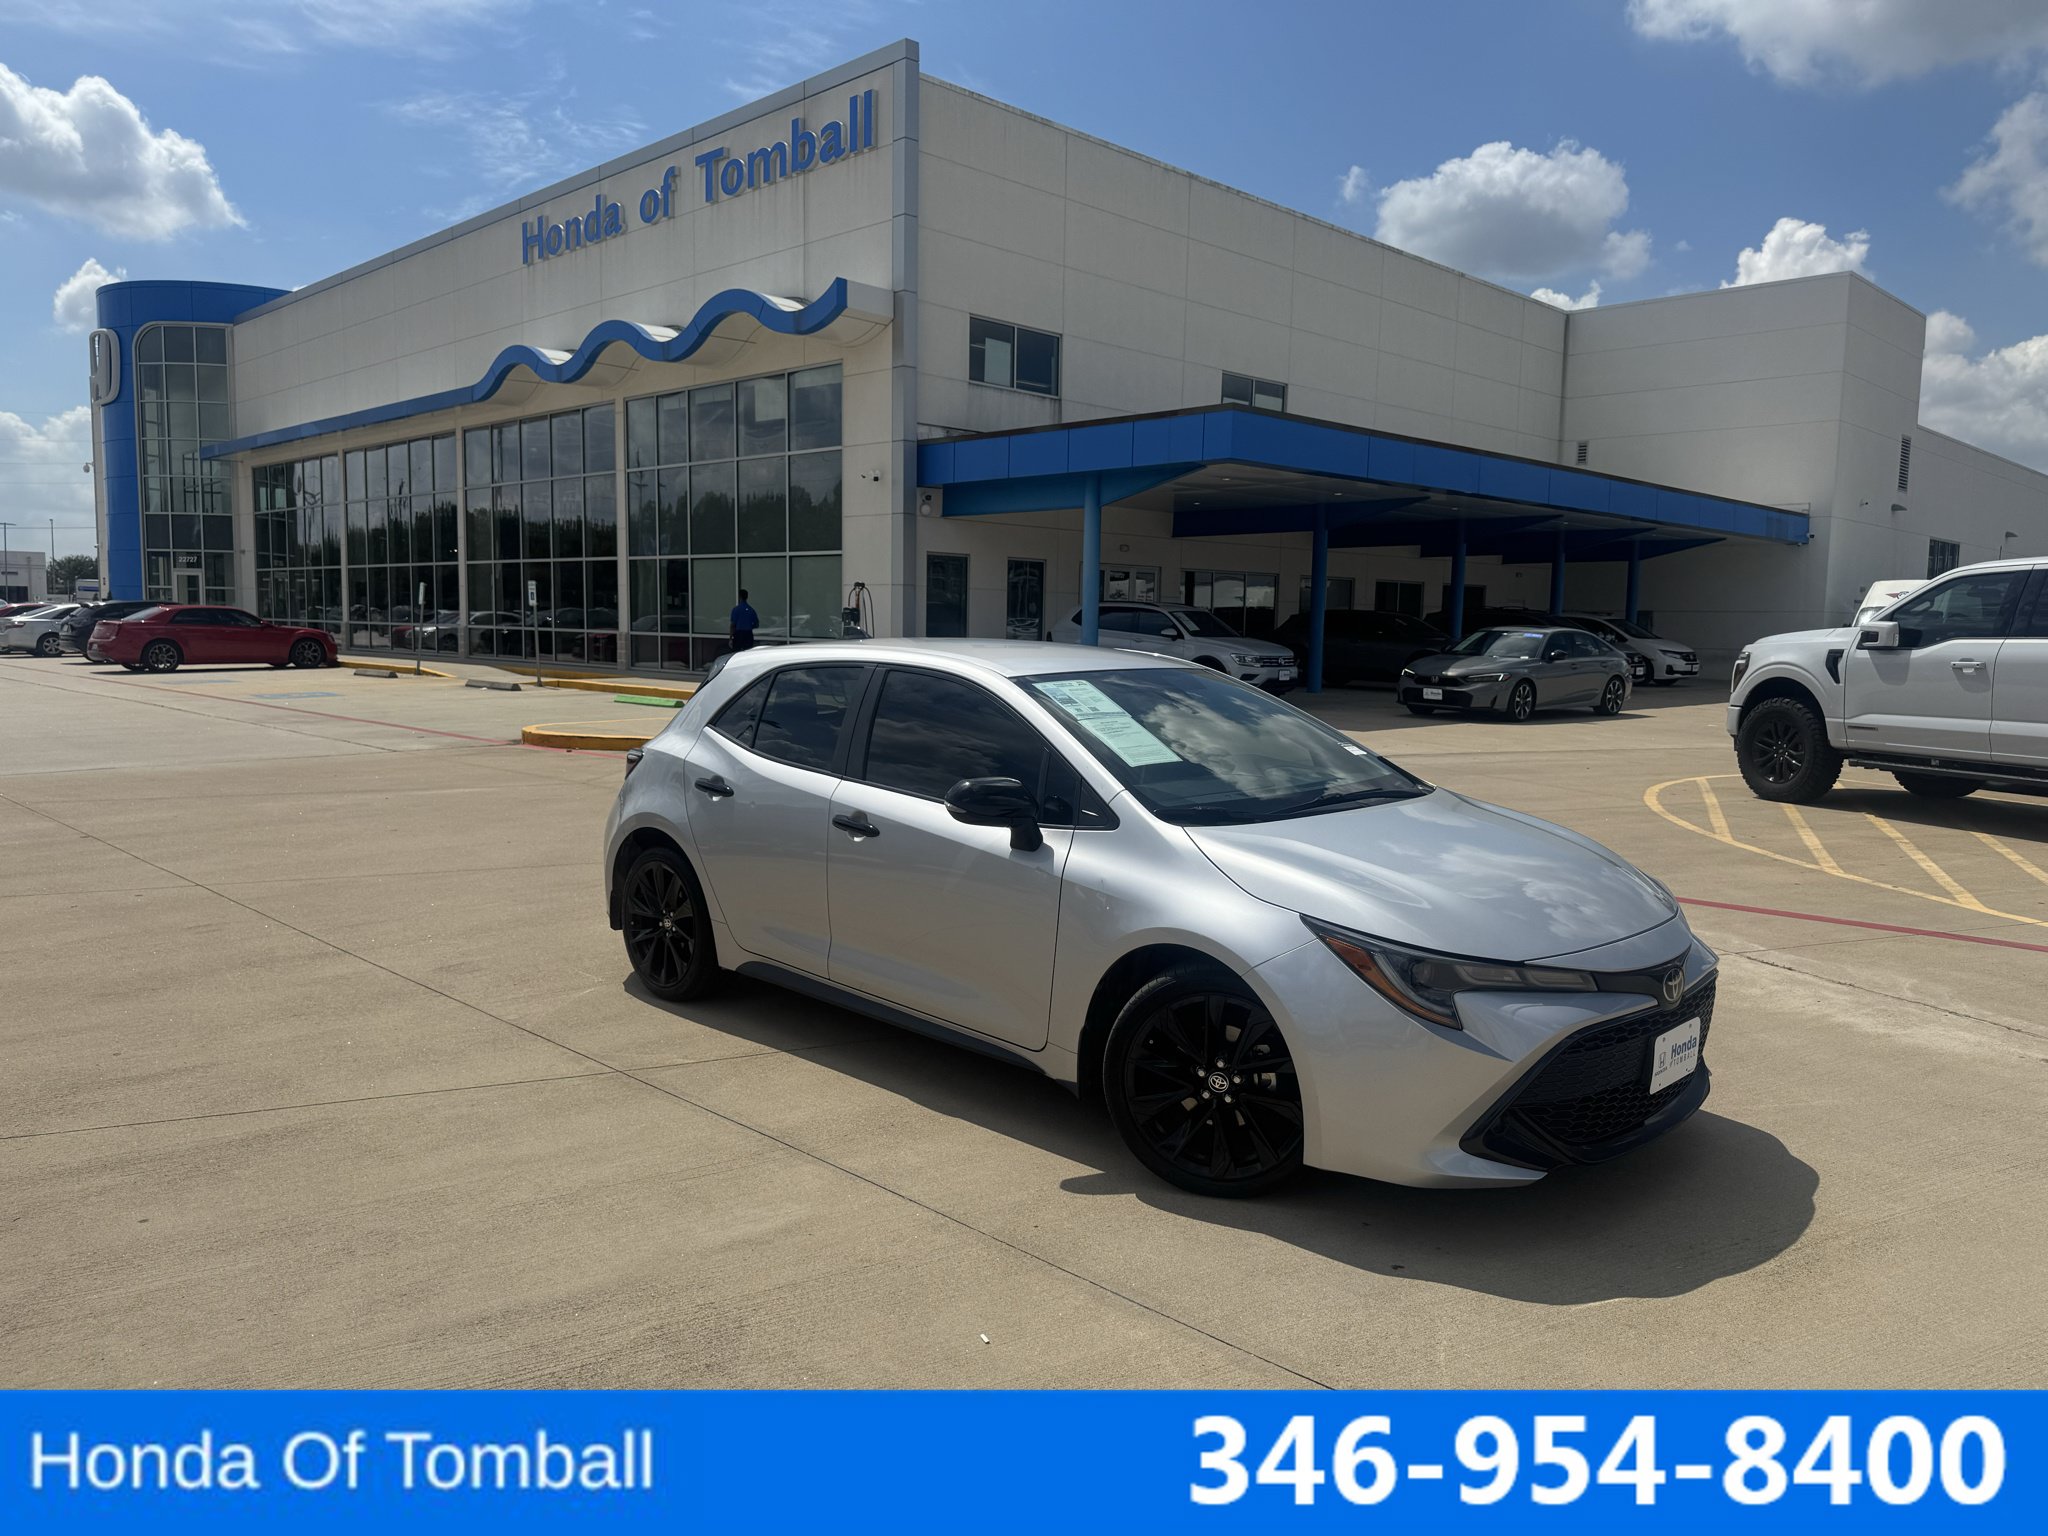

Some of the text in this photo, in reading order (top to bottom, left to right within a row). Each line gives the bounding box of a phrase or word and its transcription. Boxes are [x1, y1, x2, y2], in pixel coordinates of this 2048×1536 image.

[522, 88, 877, 265] Honda of Tomball
[1671, 1035, 1697, 1060] Honda
